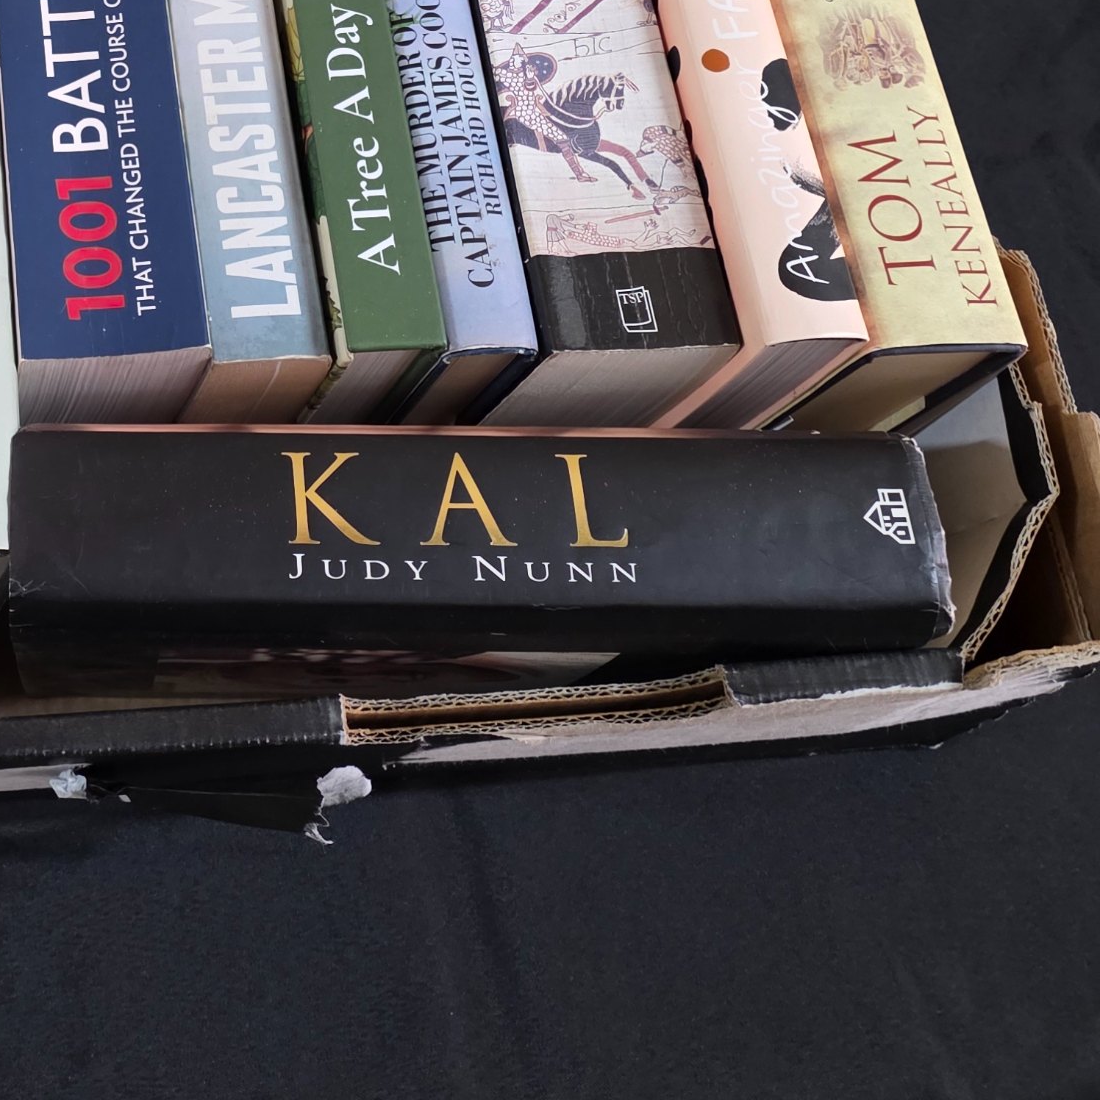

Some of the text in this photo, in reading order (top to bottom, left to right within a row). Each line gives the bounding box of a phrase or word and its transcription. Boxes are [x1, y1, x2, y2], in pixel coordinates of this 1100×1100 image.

[102, 13, 131, 93] COURSE
[109, 97, 135, 138] THE
[426, 55, 471, 148] JAMES
[197, 36, 302, 319] LANCASTER
[325, 3, 401, 276] A Tree A Day
[386, 10, 456, 253] THE MURDER OF
[451, 36, 503, 217] RICHARD HOUGH
[55, 176, 126, 321] 1001
[119, 144, 149, 251] CHANGED
[444, 154, 495, 288] CAPTAIN
[846, 129, 938, 286] TOM
[905, 104, 999, 308] KENEALLY
[131, 257, 157, 315] THAT
[621, 291, 644, 306] TSP
